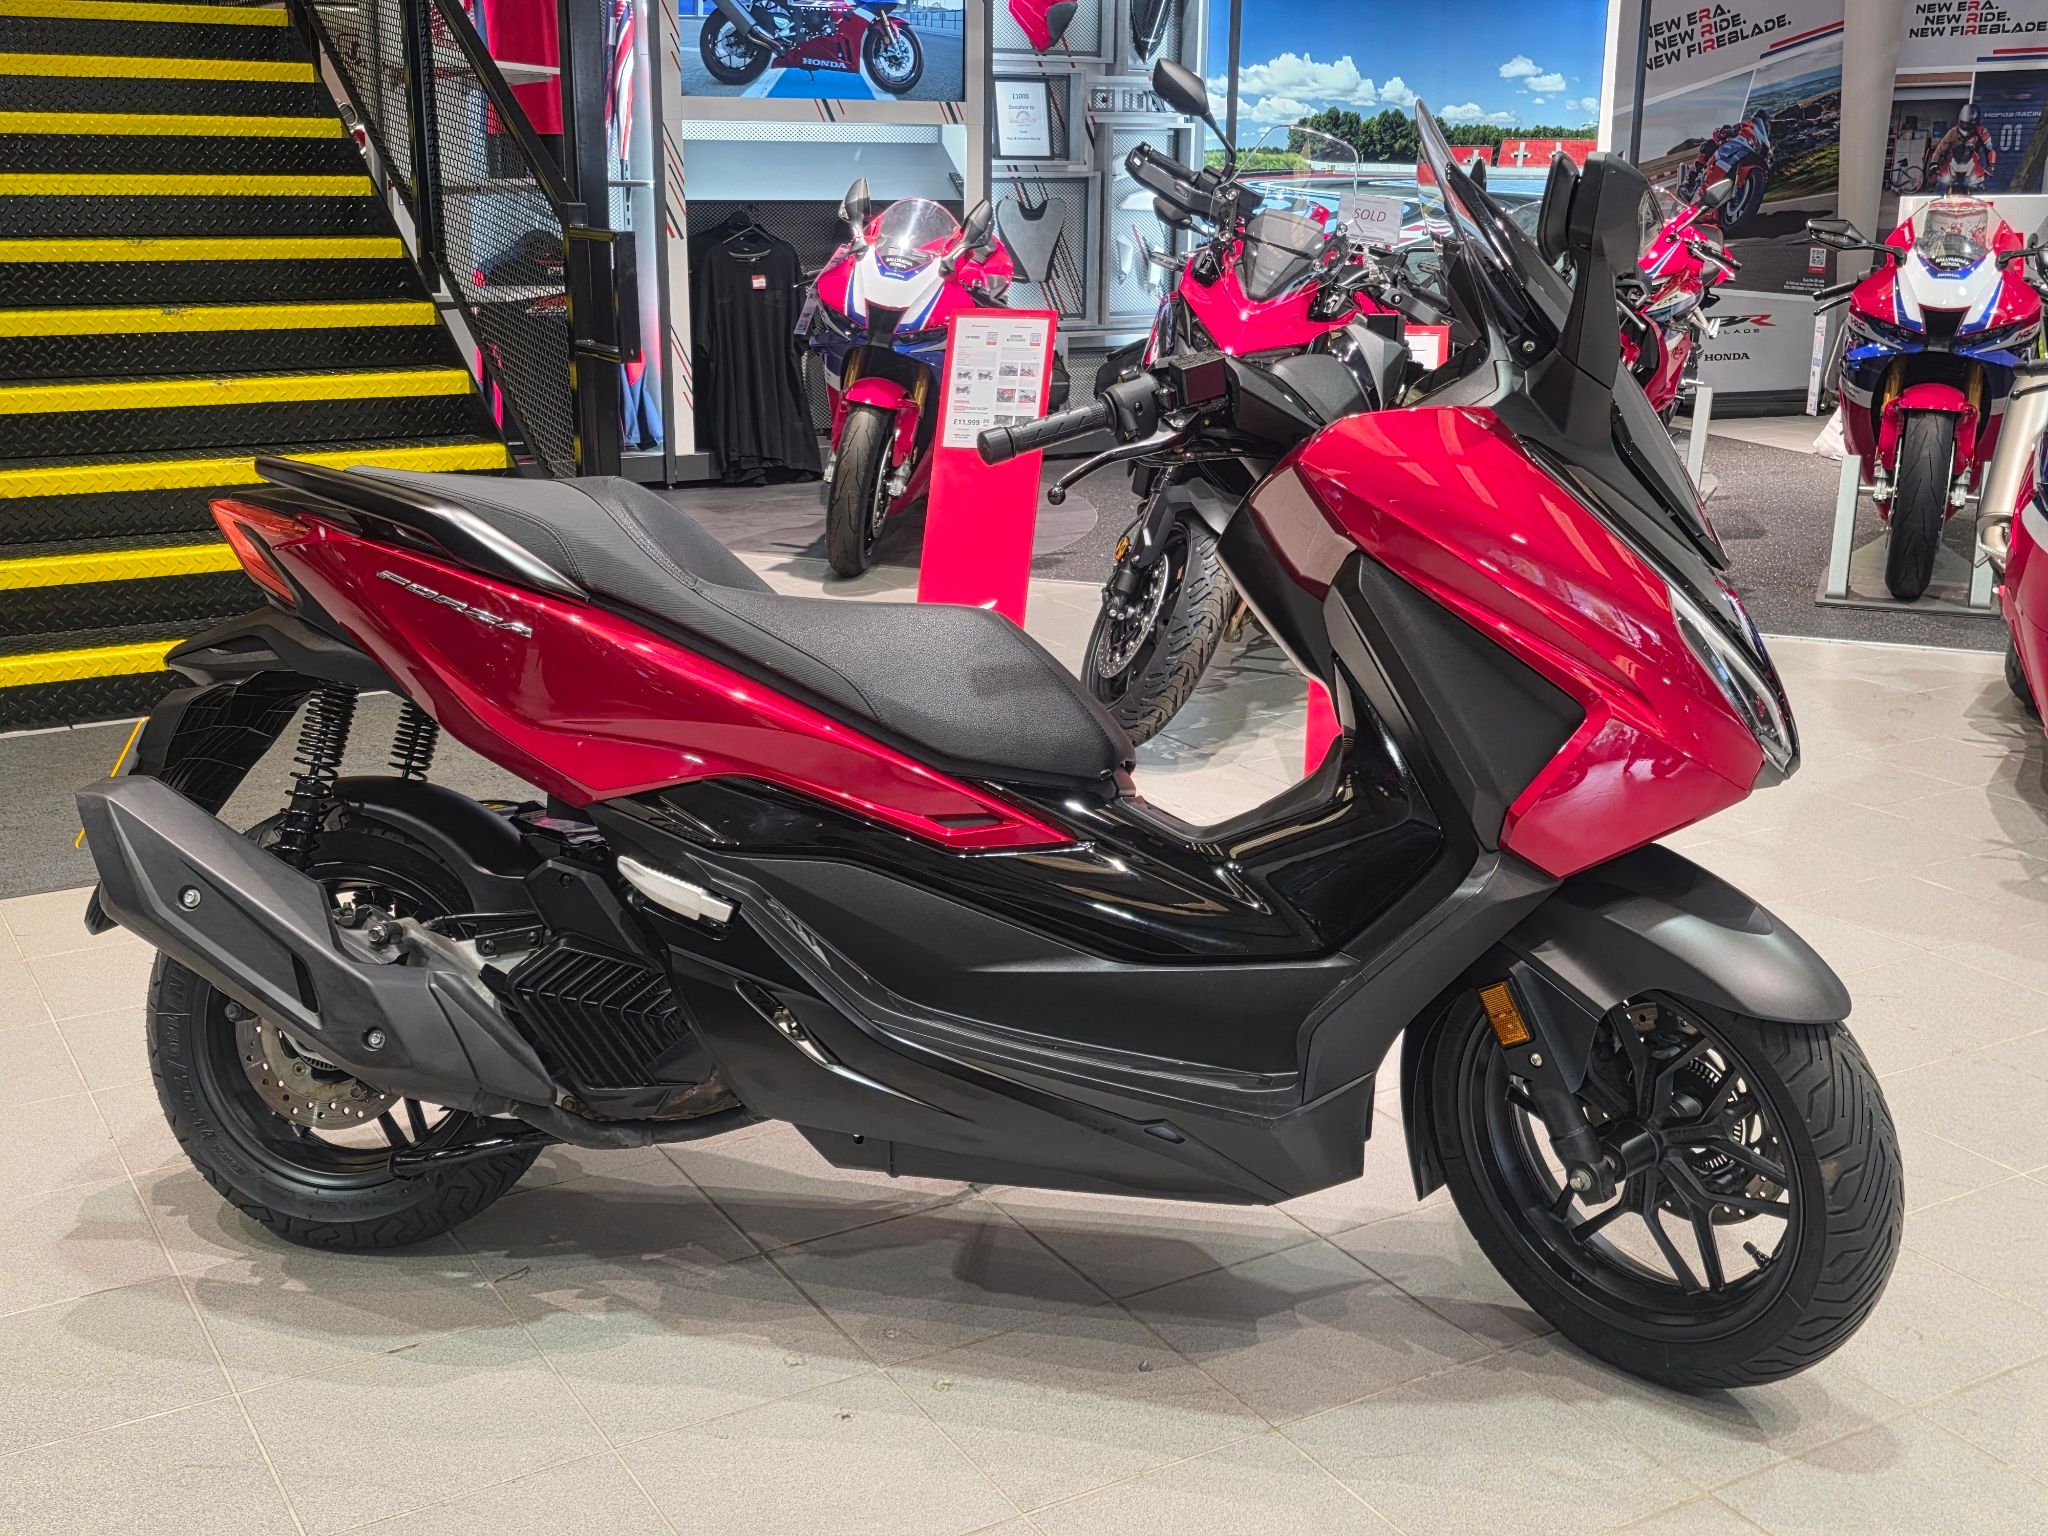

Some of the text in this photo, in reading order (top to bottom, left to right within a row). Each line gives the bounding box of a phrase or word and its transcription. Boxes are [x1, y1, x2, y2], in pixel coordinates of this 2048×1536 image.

[1916, 0, 1999, 14] NEW ERA.
[1686, 4, 1731, 26] ERA.
[1924, 11, 2010, 25] NEW RIDE.
[1655, 13, 1747, 52] NEW RIDE.
[1686, 14, 1792, 58] FIREBLADE.
[1909, 27, 1945, 38] NEW
[802, 57, 847, 69] HONDA
[2000, 124, 2022, 151] 01
[1354, 208, 1387, 222] SOLD
[1704, 352, 1750, 361] HONDA
[376, 570, 533, 638] FORZA
